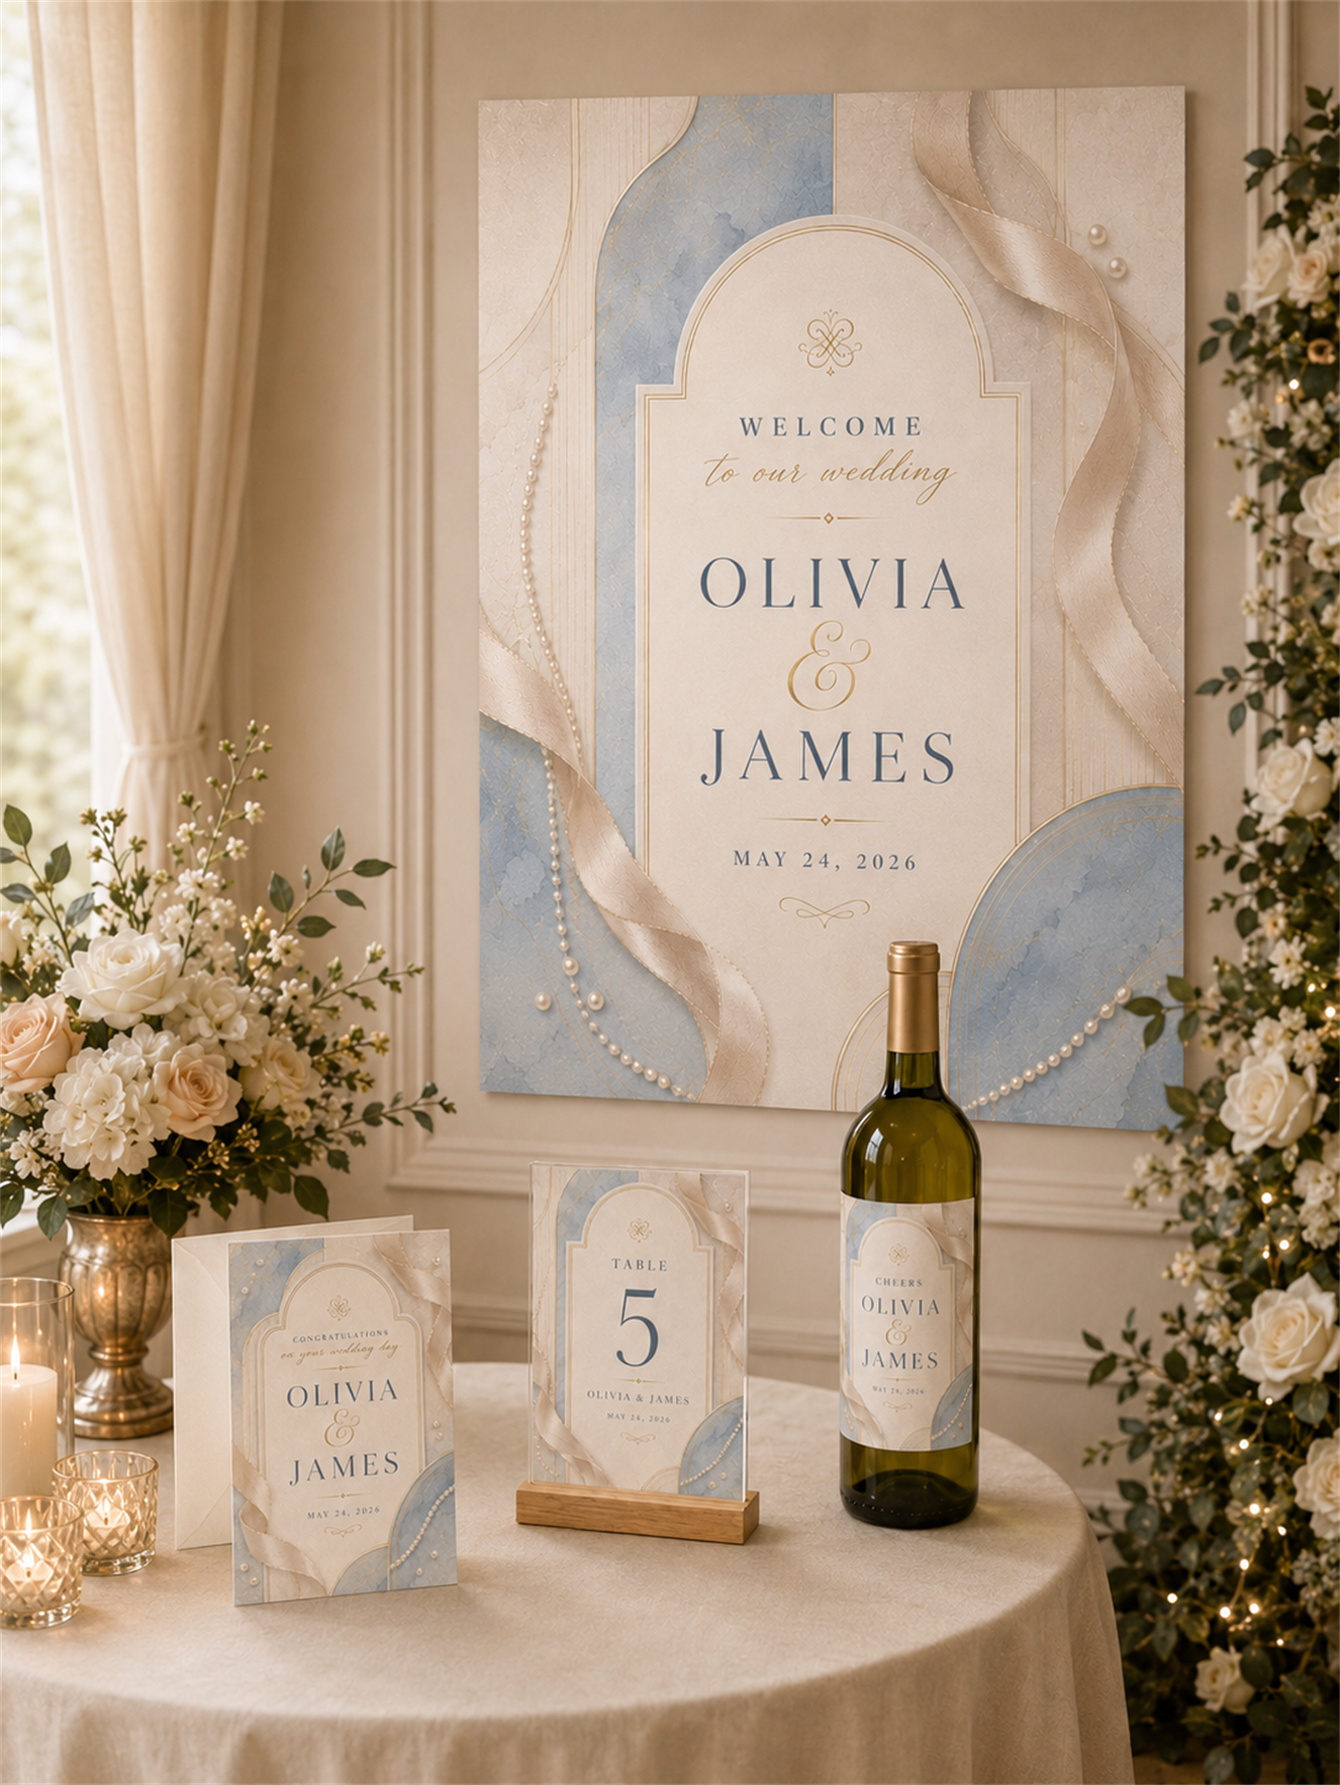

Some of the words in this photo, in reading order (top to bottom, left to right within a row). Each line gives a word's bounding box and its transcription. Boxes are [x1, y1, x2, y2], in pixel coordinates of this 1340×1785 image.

[739, 416, 921, 437] WELCOME
[704, 453, 740, 487] to
[753, 463, 807, 484] our
[820, 449, 957, 506] wedding
[700, 556, 965, 610] OLIVIA
[787, 620, 872, 712] &
[700, 728, 954, 787] JAMES
[733, 850, 787, 867] MAY
[802, 852, 841, 872] 24,
[856, 853, 917, 871] 2026
[611, 1257, 668, 1272] TABLE
[875, 1277, 924, 1288] CHEERS
[861, 1295, 940, 1316] OLIVIA
[292, 1329, 389, 1343] CONGRATULATIONS
[616, 1288, 659, 1368] 5
[885, 1318, 912, 1346] &
[861, 1349, 938, 1370] JAMES
[286, 1379, 398, 1409] OLIVIA
[587, 1390, 631, 1402] OLIVIA
[635, 1394, 644, 1402] &
[649, 1394, 690, 1406] JAMES
[324, 1408, 361, 1448] &
[607, 1412, 626, 1420] MAY
[649, 1415, 671, 1424] 2026
[289, 1451, 399, 1487] JAMES
[307, 1510, 329, 1520] MAY
[335, 1509, 351, 1517] 24,
[356, 1506, 380, 1515] 2026
